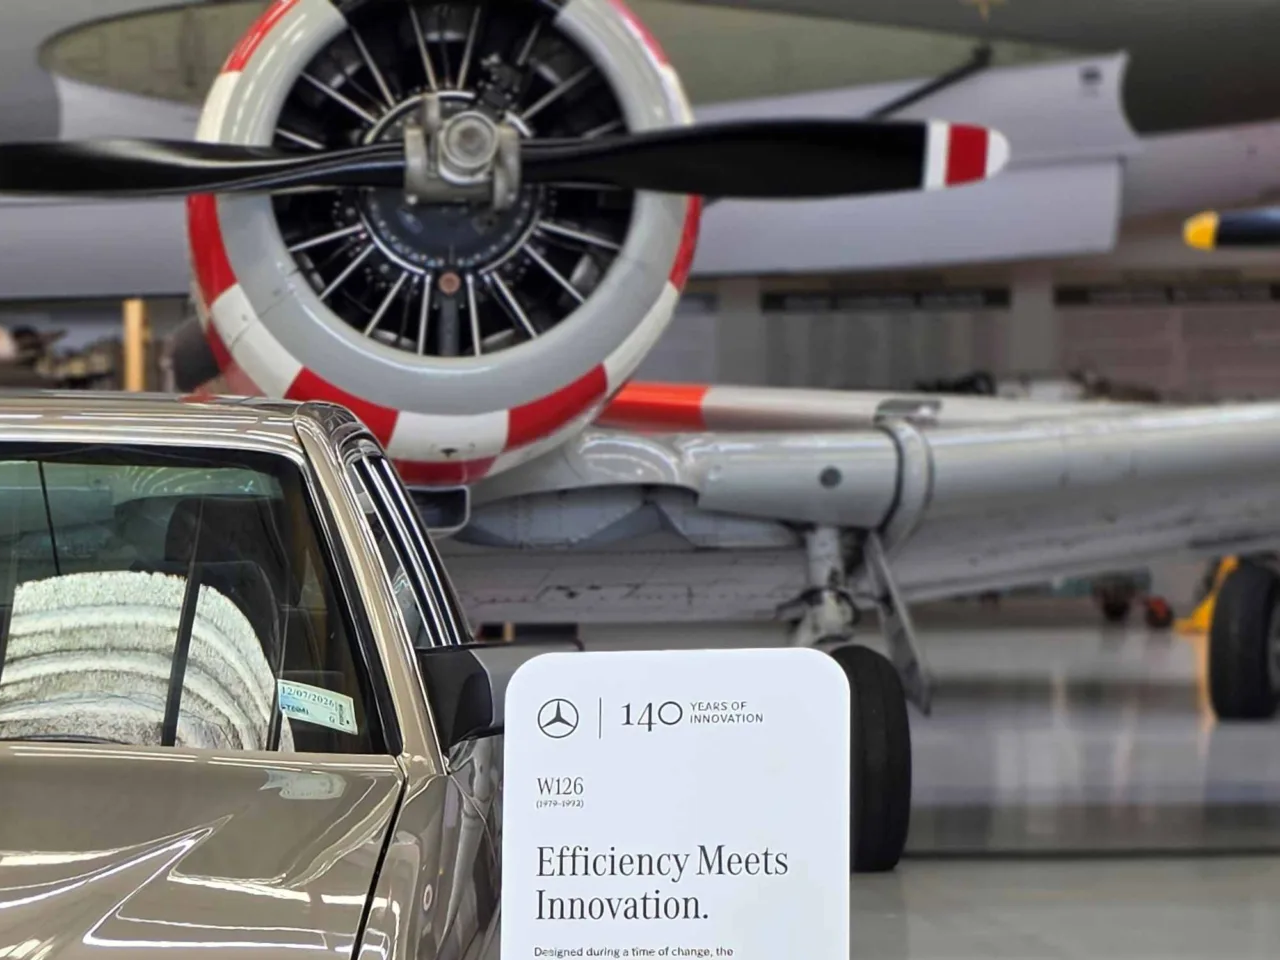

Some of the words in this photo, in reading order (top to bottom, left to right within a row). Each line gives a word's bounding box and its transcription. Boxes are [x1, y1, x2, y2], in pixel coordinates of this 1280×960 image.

[690, 701, 727, 712] YEARS
[731, 701, 747, 711] OF
[621, 701, 683, 732] 140
[690, 713, 763, 724] INNOVATION
[536, 777, 584, 796] W126
[536, 847, 691, 883] Efficiency
[696, 845, 788, 876] Meets
[536, 889, 708, 920] Innovation.
[534, 946, 583, 959] Designed
[586, 946, 620, 959] during
[622, 949, 629, 957] a
[631, 946, 656, 957] time
[658, 946, 669, 957] of
[671, 946, 713, 959] change,
[716, 946, 734, 957] the
